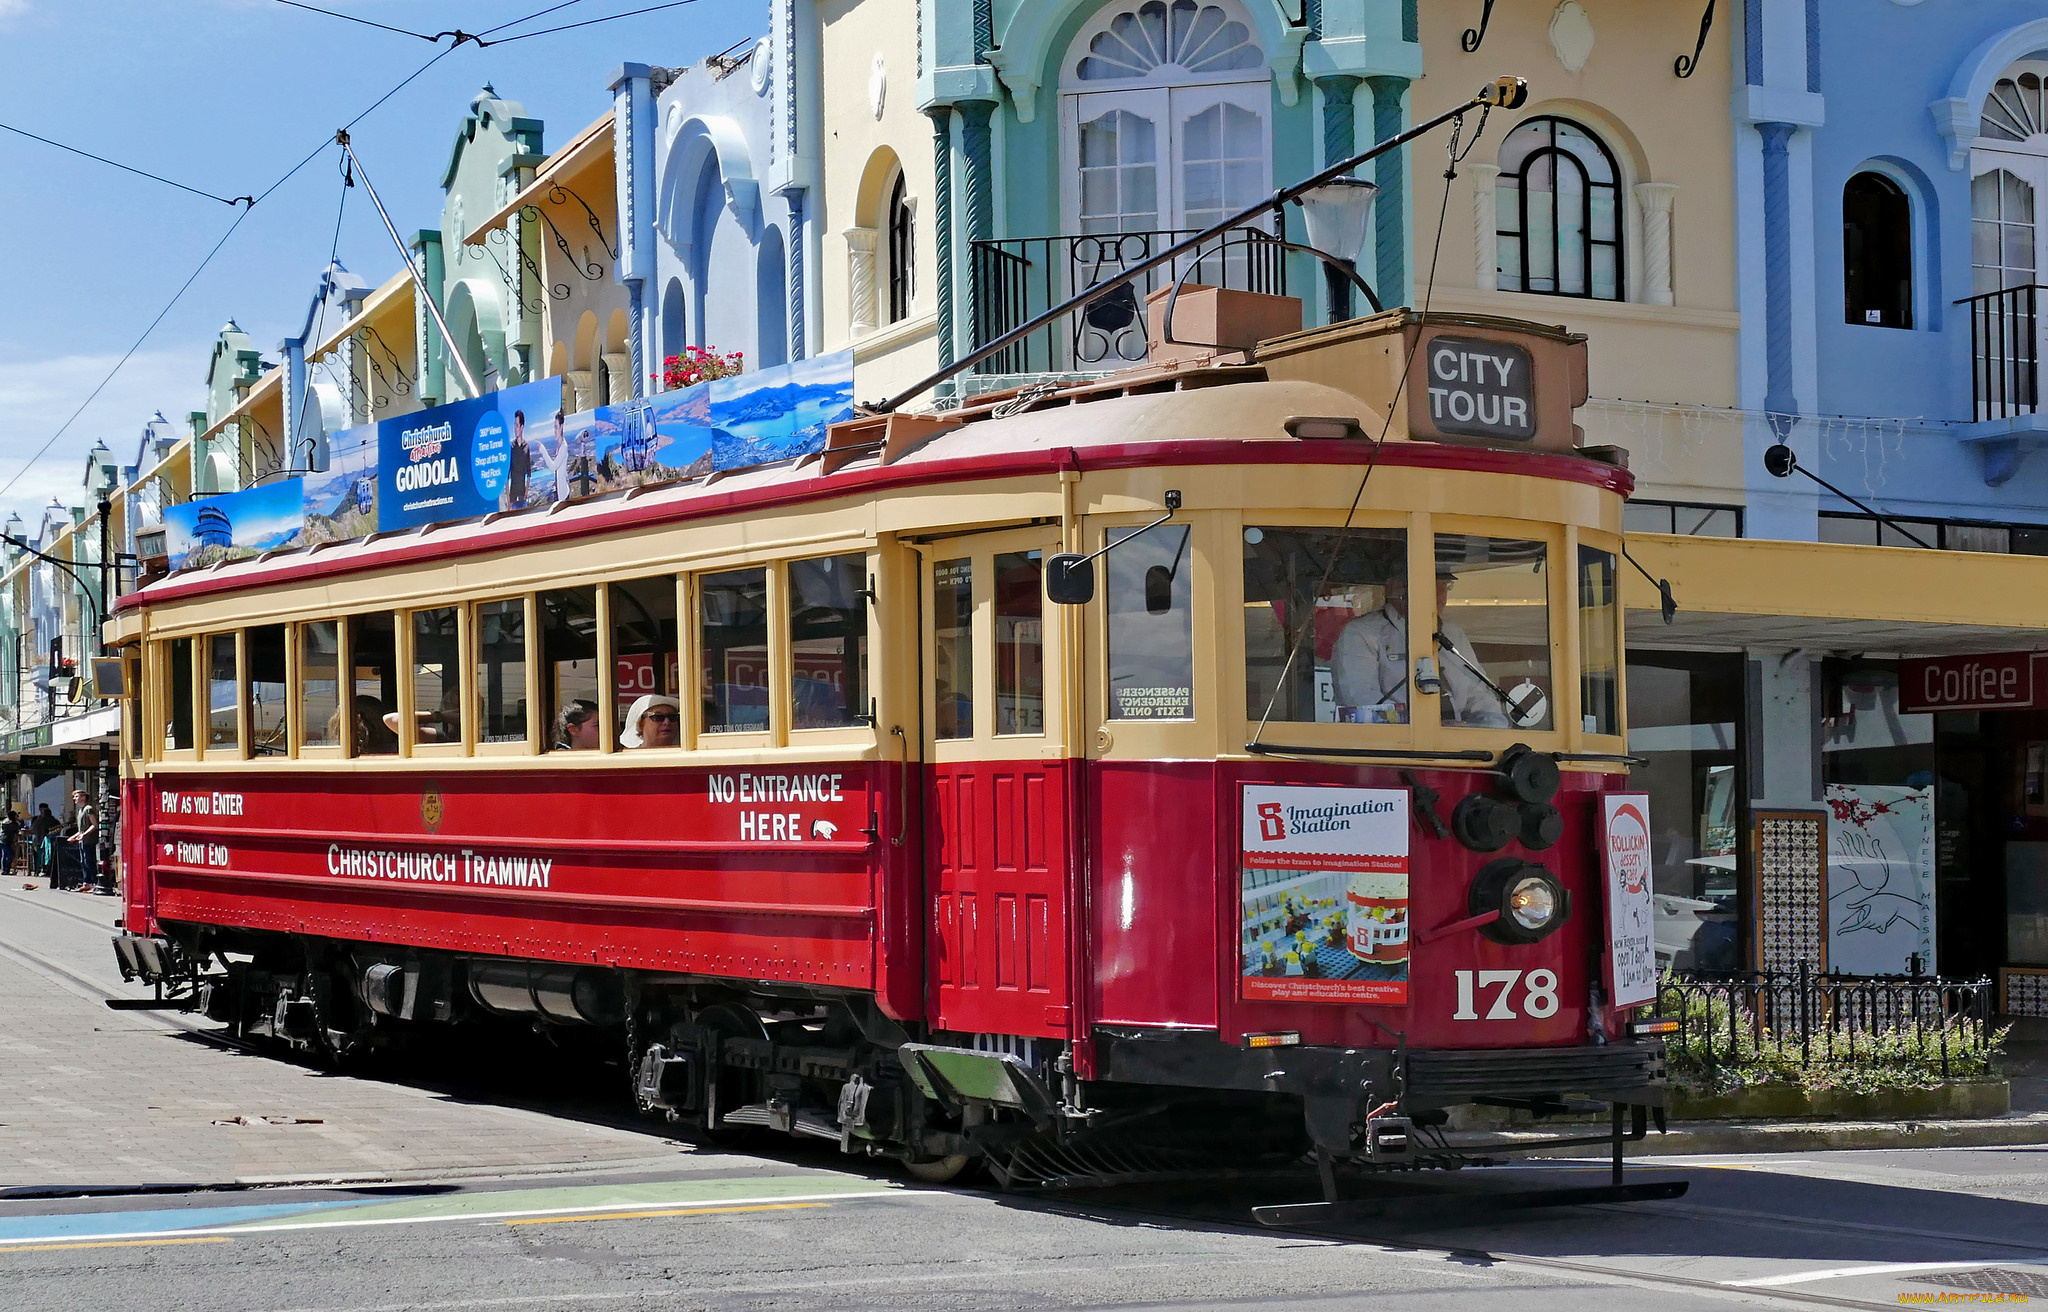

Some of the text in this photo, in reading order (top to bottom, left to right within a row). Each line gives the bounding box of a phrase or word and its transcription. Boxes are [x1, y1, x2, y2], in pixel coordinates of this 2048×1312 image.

[1433, 349, 1515, 387] CITY
[1428, 387, 1528, 428] TOUR
[401, 421, 452, 450] Christchurch
[478, 438, 503, 451] Time Tunnel
[395, 456, 459, 492] GONDOLA
[475, 457, 486, 467] Shop
[498, 452, 507, 463] Top
[1924, 662, 2018, 703] Coffee
[708, 773, 844, 803] NO ENTRANCE
[161, 791, 244, 816] PAY AS YOU ENTER
[1286, 799, 1394, 821] Imagination
[740, 810, 802, 841] HERE
[1290, 819, 1351, 835] Station
[1920, 802, 1931, 878] CHINESE
[177, 840, 228, 866] FRONT END
[327, 843, 553, 888] CHRISTCHURCH TRAMWAY
[1249, 857, 1276, 865] Follow
[1276, 857, 1291, 865] the
[1323, 859, 1370, 868] Imagination
[1920, 892, 1931, 968] MASSAGE
[1251, 981, 1286, 989] Discover
[1288, 982, 1346, 991] Christchurch's
[1271, 989, 1290, 997] play
[1453, 968, 1559, 1020] 178
